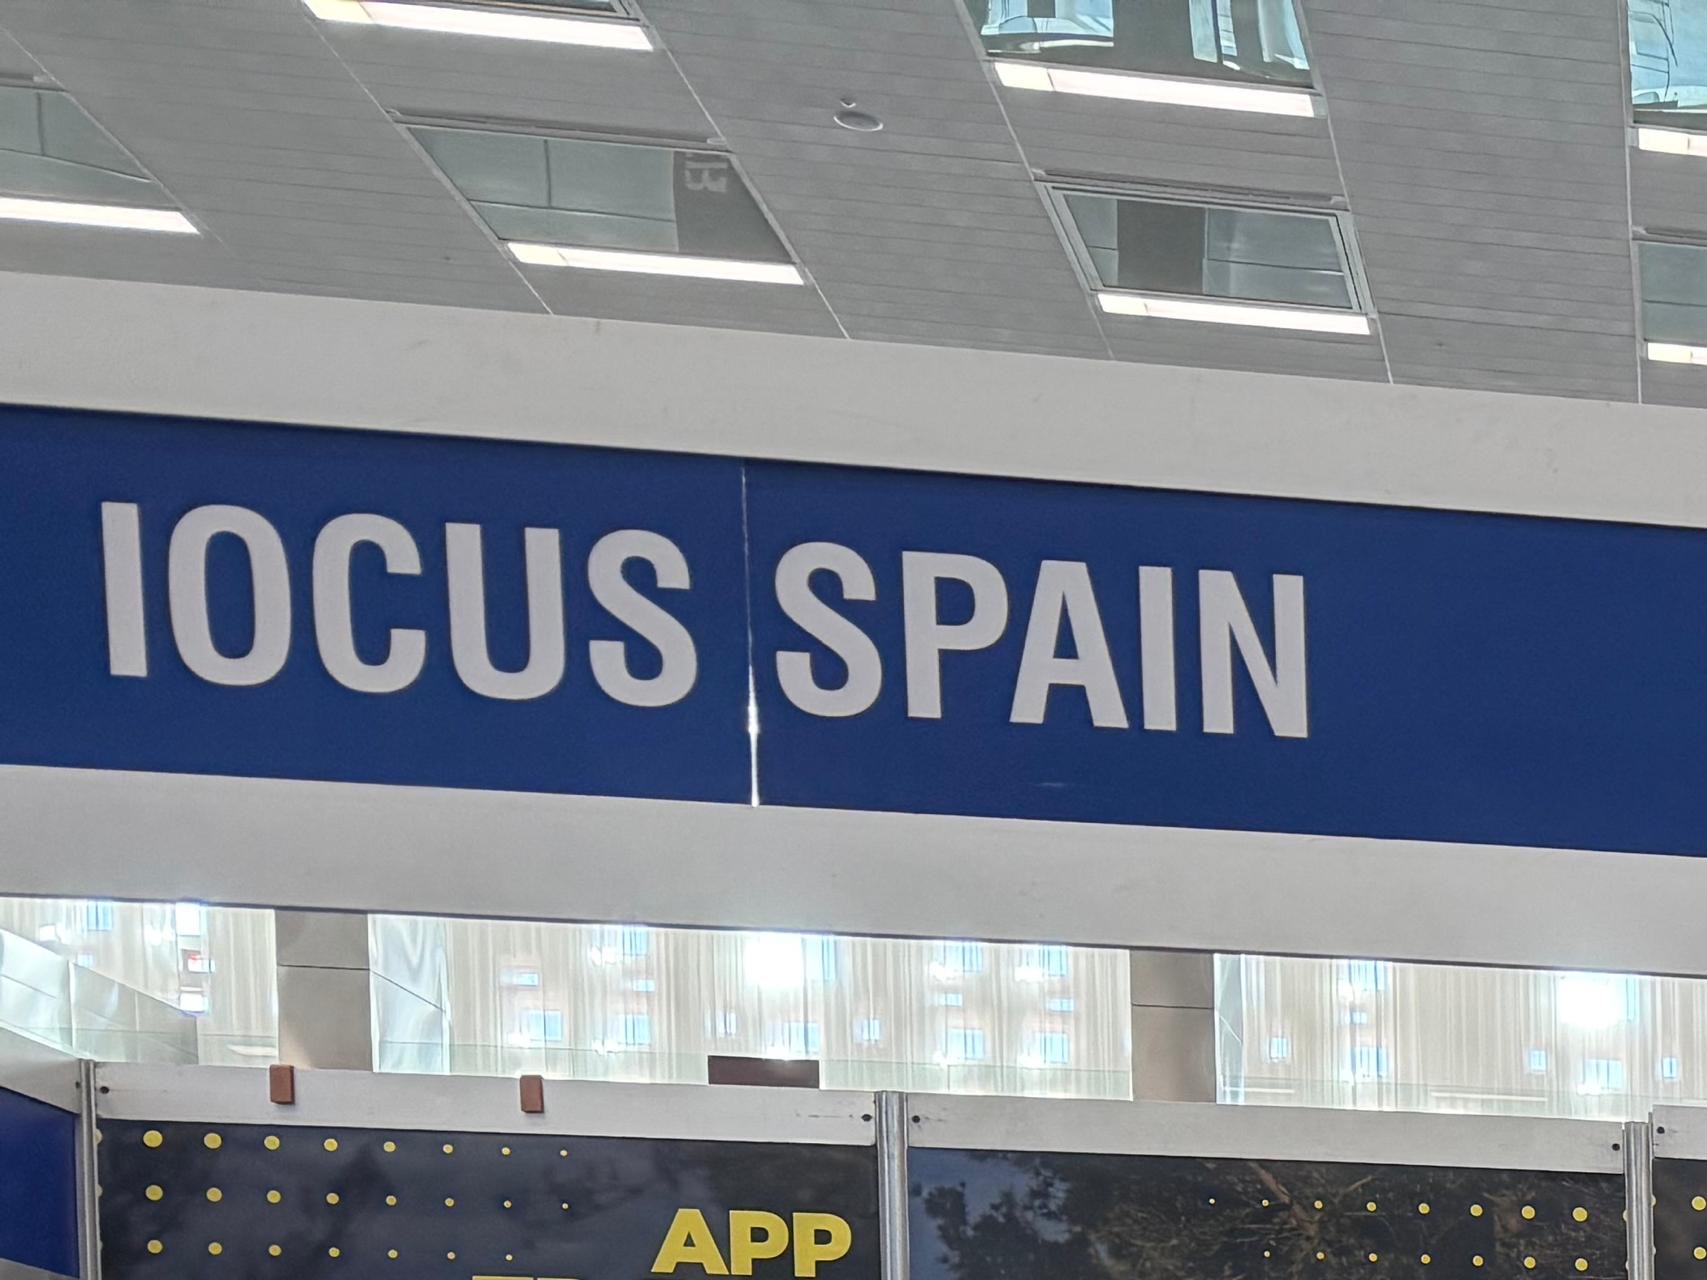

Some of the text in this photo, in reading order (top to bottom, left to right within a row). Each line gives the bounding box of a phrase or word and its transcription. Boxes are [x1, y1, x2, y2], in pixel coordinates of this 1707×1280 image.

[101, 502, 1308, 737] IOCUS SPAIN
[651, 1208, 852, 1278] APP
